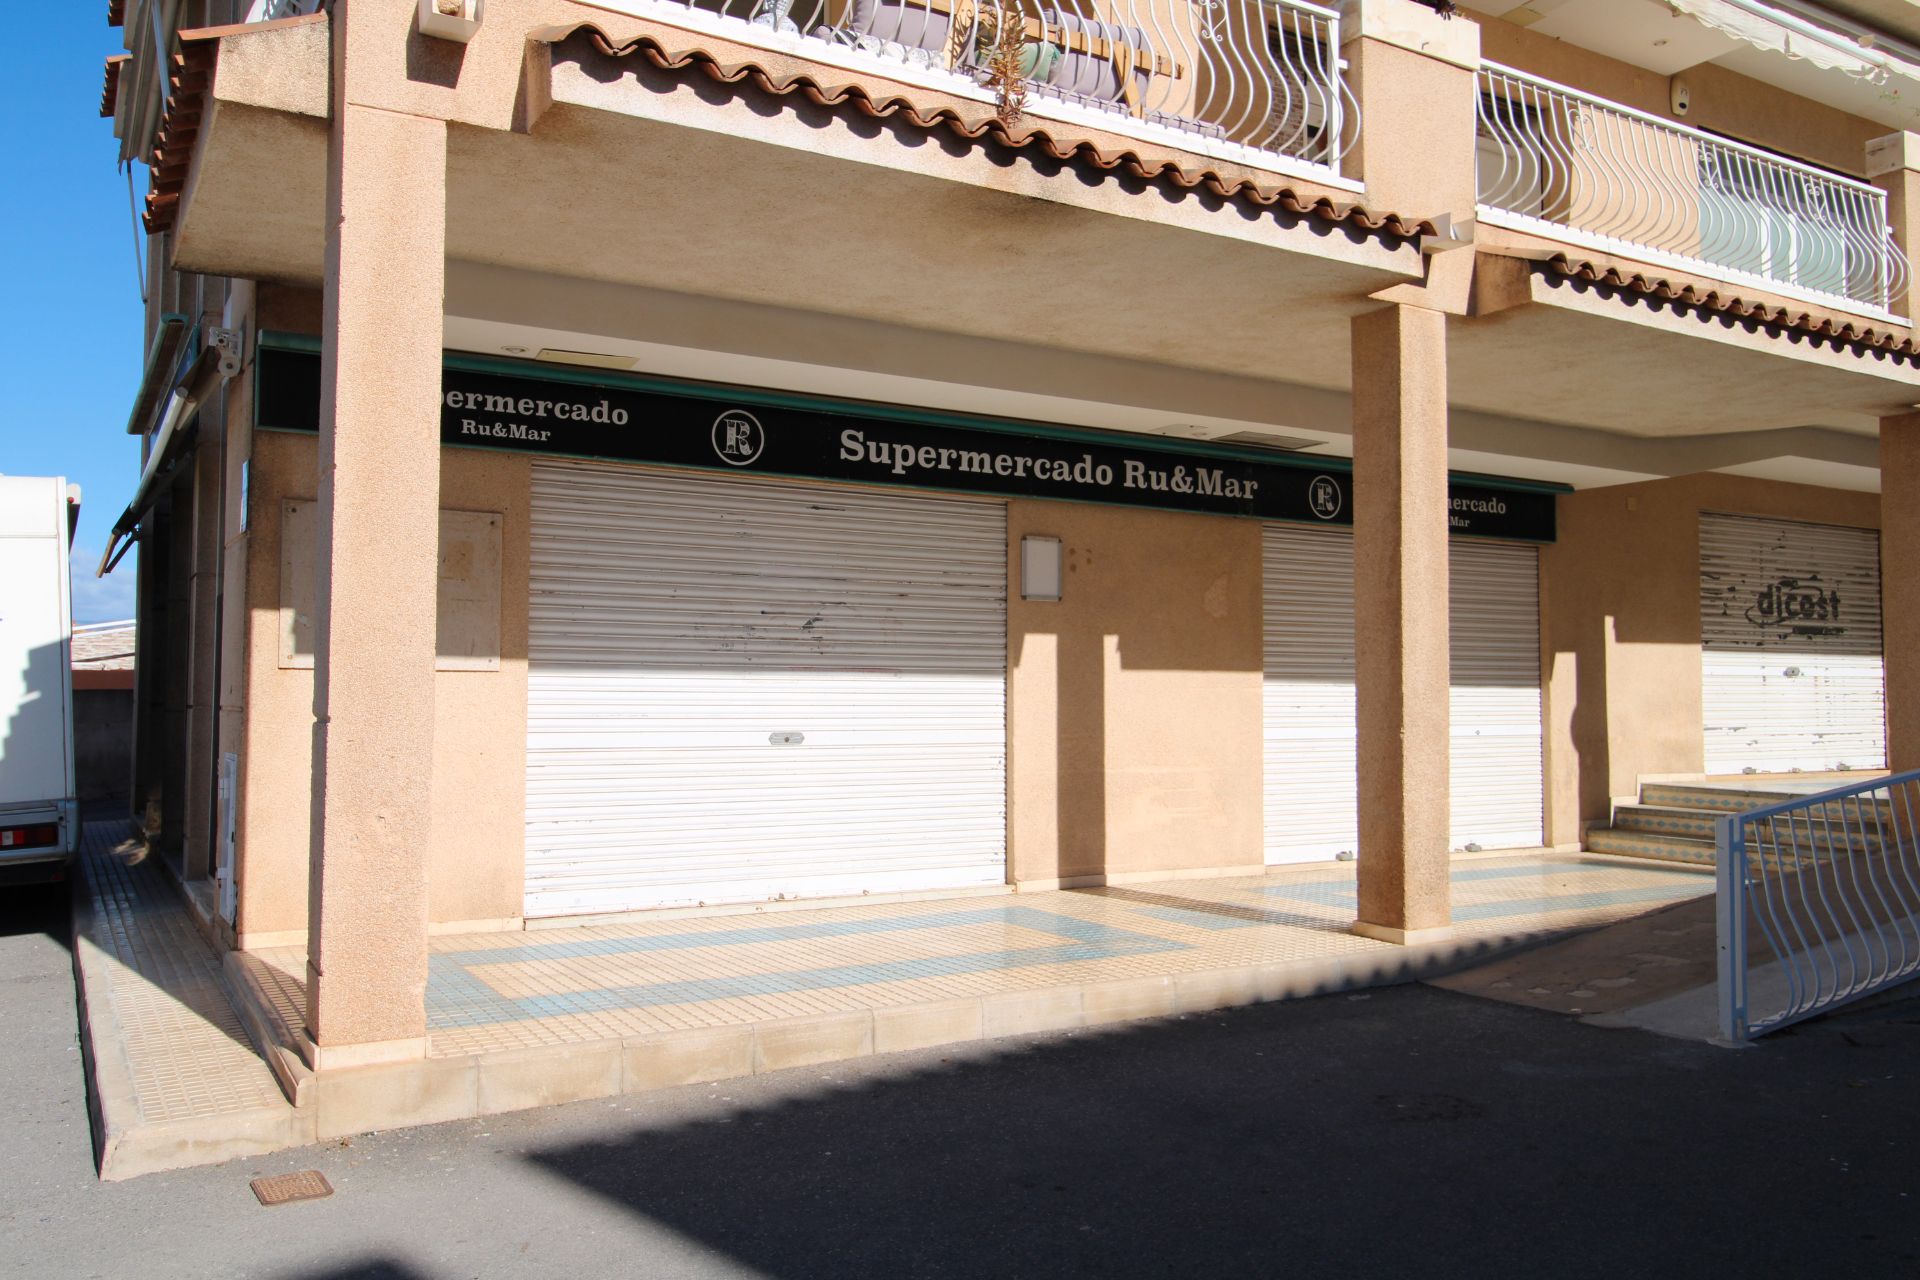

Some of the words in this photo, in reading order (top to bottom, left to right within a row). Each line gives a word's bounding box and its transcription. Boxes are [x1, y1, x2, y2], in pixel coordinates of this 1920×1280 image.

[461, 418, 551, 441] Ru&Mar
[839, 429, 1113, 486] Supermercado
[1123, 459, 1259, 499] Ru&Mar
